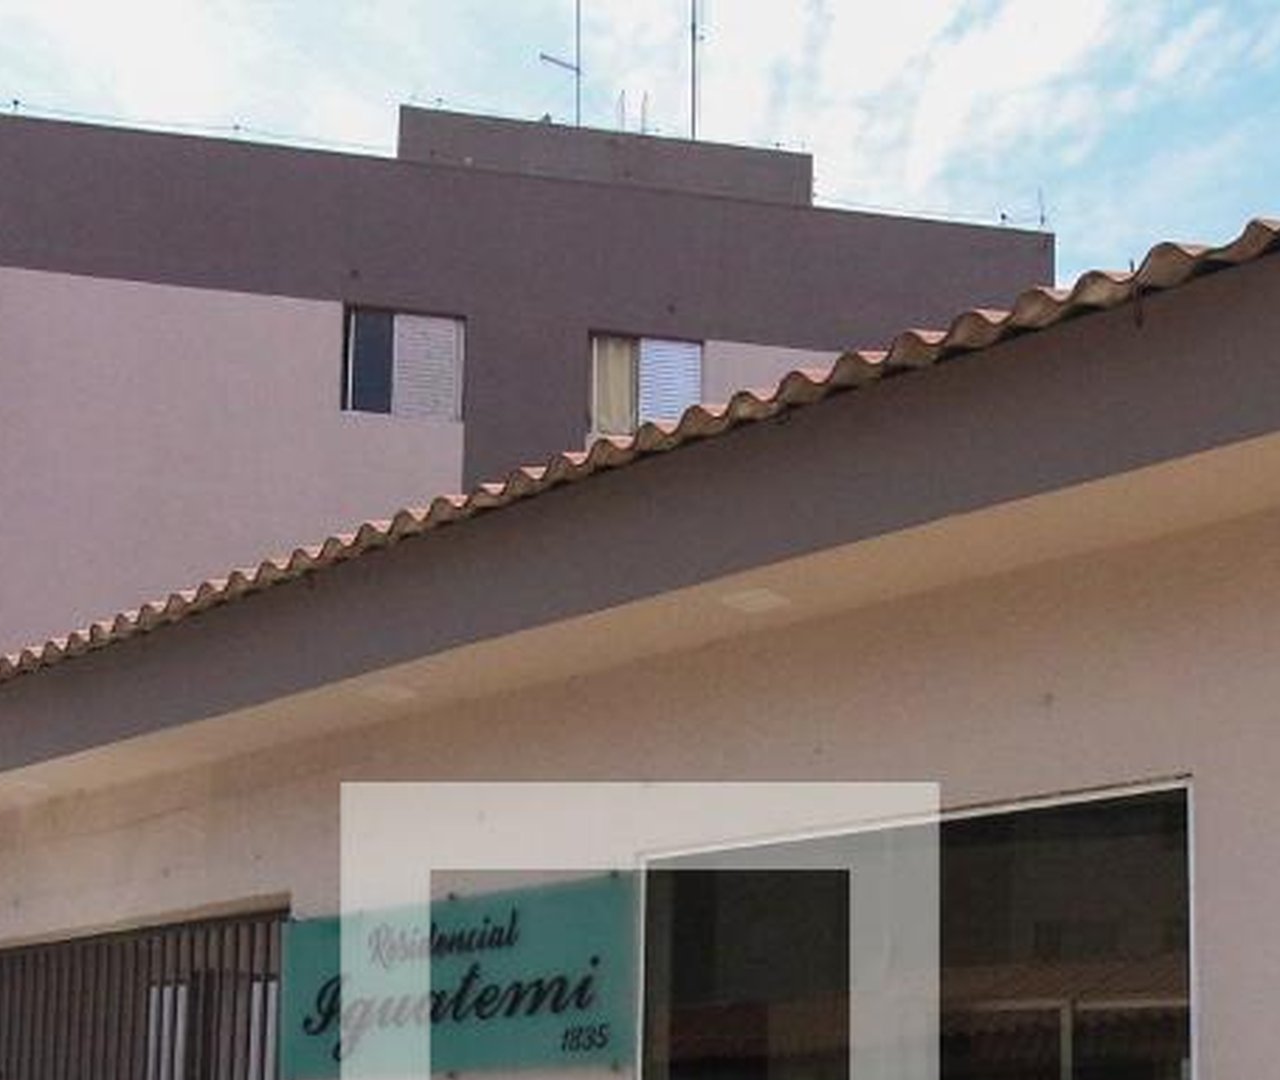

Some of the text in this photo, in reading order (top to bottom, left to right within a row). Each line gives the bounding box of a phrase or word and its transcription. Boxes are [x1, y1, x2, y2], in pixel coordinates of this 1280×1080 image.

[368, 906, 519, 970] Residencial
[302, 954, 601, 1064] Iguatemi
[561, 1022, 610, 1052] 1835
